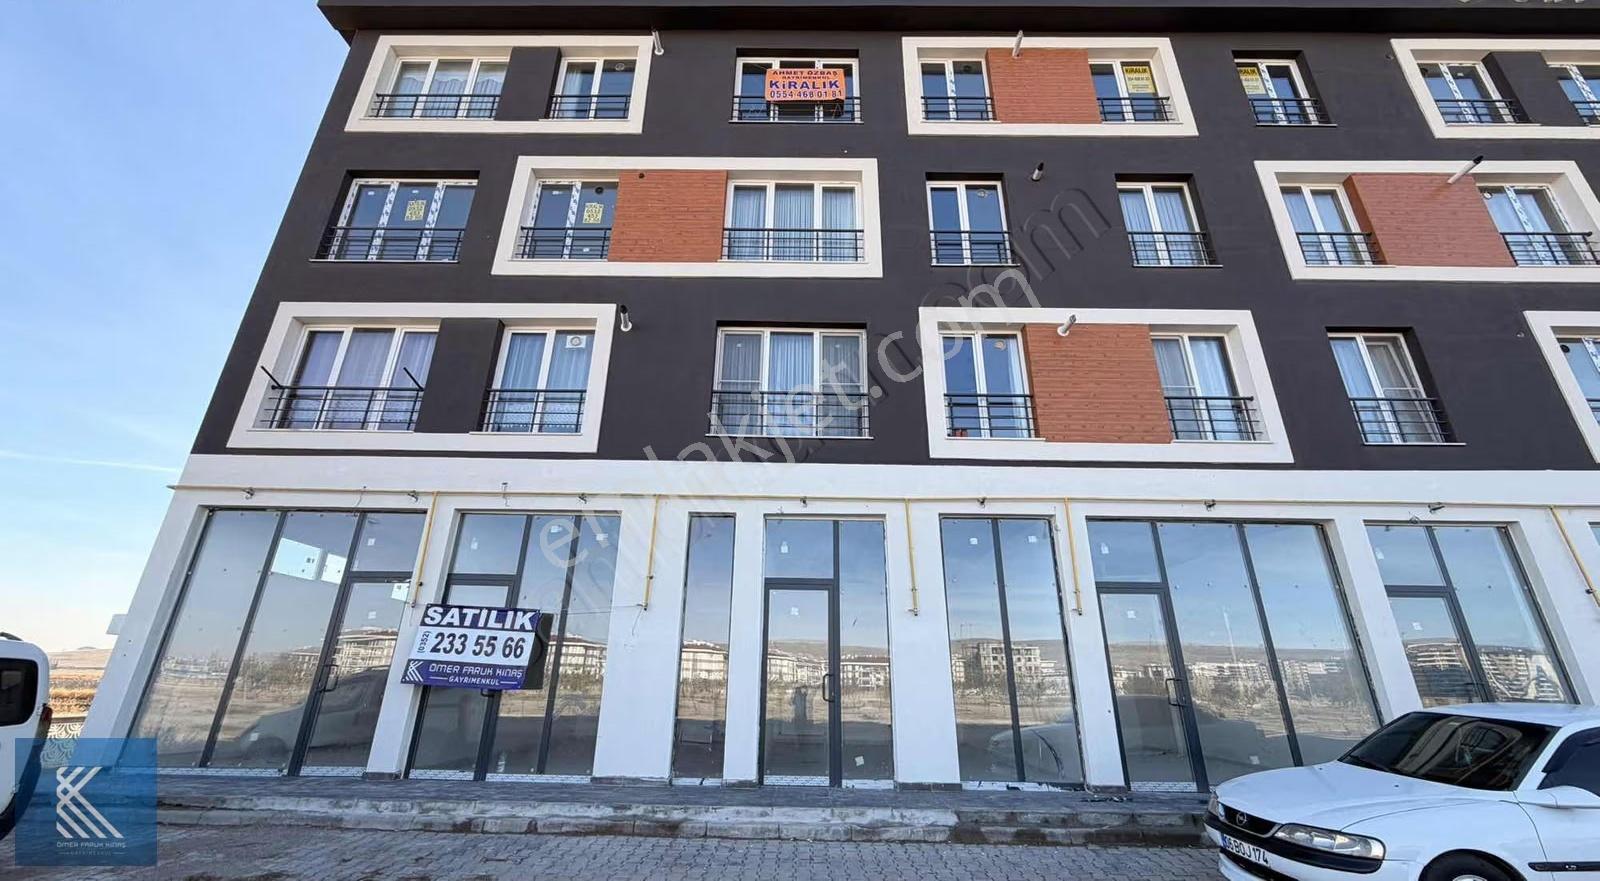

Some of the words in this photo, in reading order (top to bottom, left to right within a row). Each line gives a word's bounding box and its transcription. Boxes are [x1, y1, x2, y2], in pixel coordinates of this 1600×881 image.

[770, 90, 794, 98] 0554
[796, 90, 814, 98] 468
[831, 90, 843, 98] 81
[424, 607, 535, 631] SATILIK
[417, 630, 432, 653] (0352)
[430, 632, 468, 655] 233
[472, 635, 498, 656] 55
[502, 637, 526, 658] 66
[462, 666, 494, 676] FARUK
